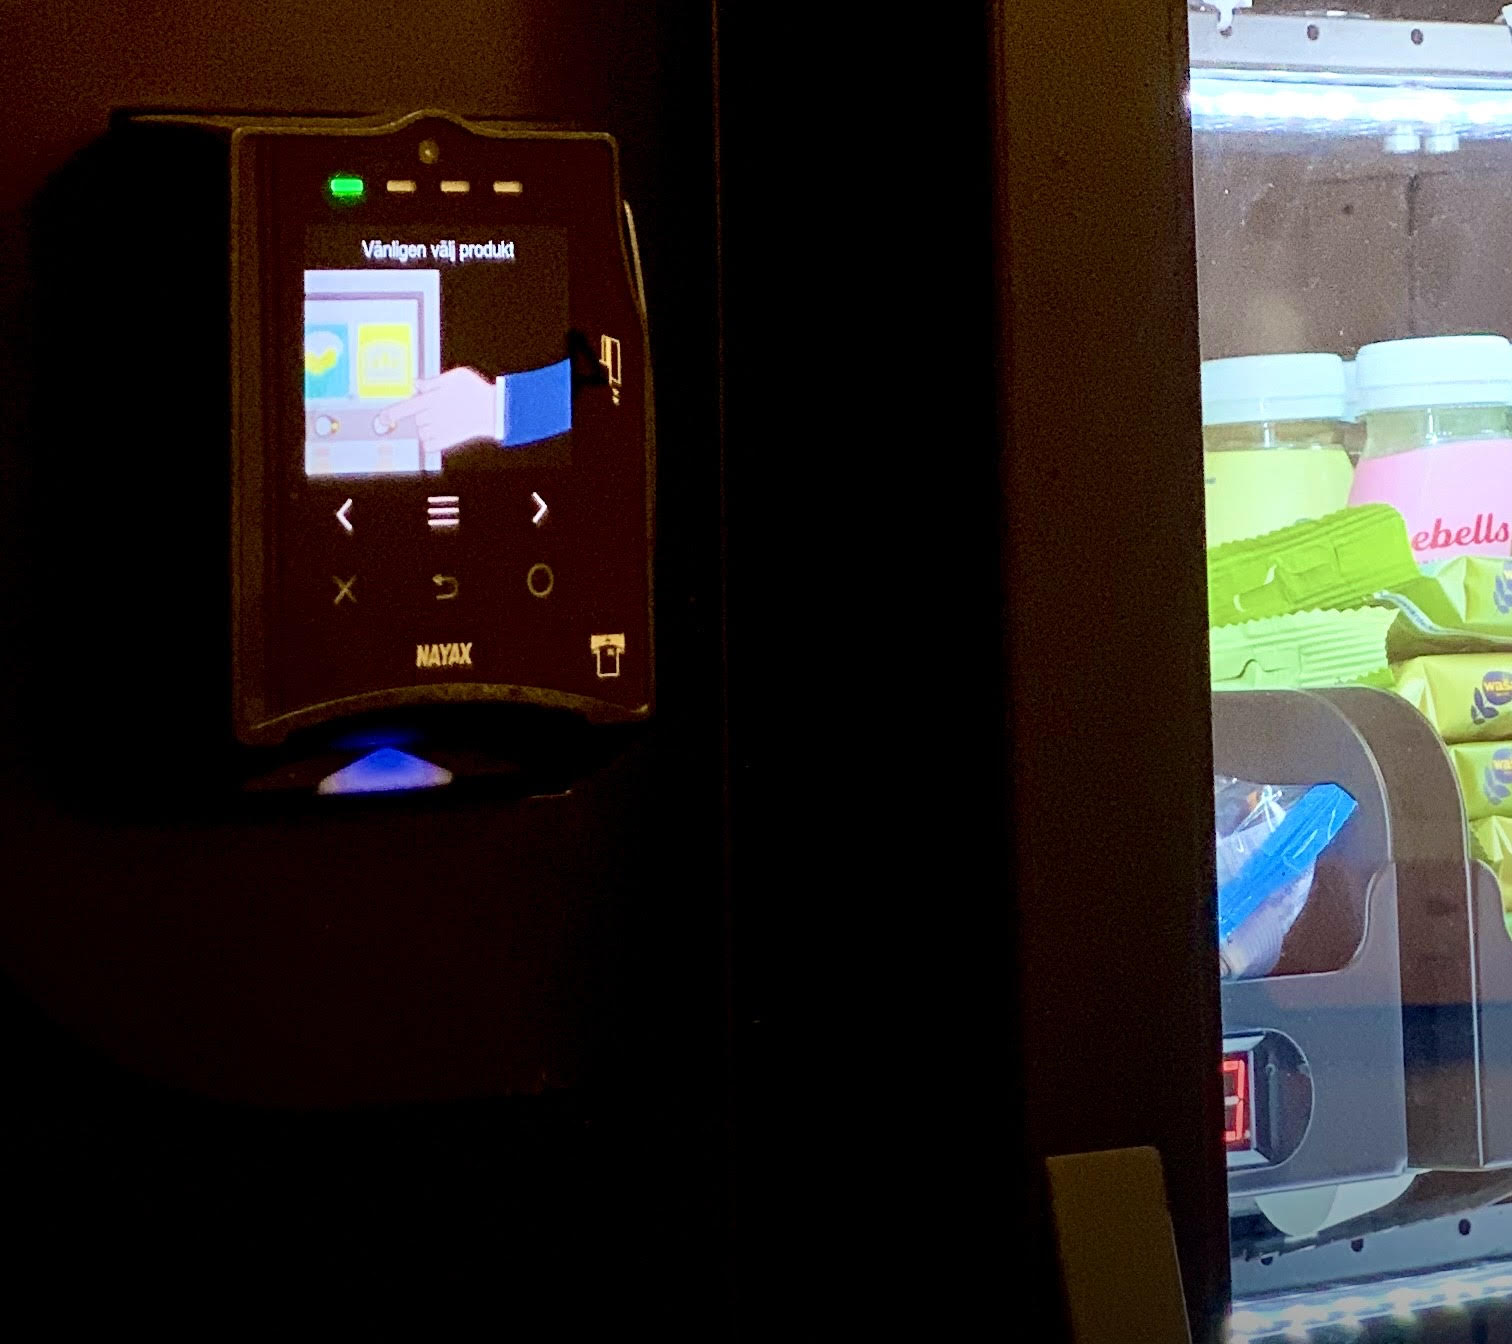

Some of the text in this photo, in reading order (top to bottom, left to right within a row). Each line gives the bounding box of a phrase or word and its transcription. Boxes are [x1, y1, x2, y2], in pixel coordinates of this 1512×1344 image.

[361, 239, 515, 263] Vänligen välj produkt
[416, 643, 473, 668] NAYAX
